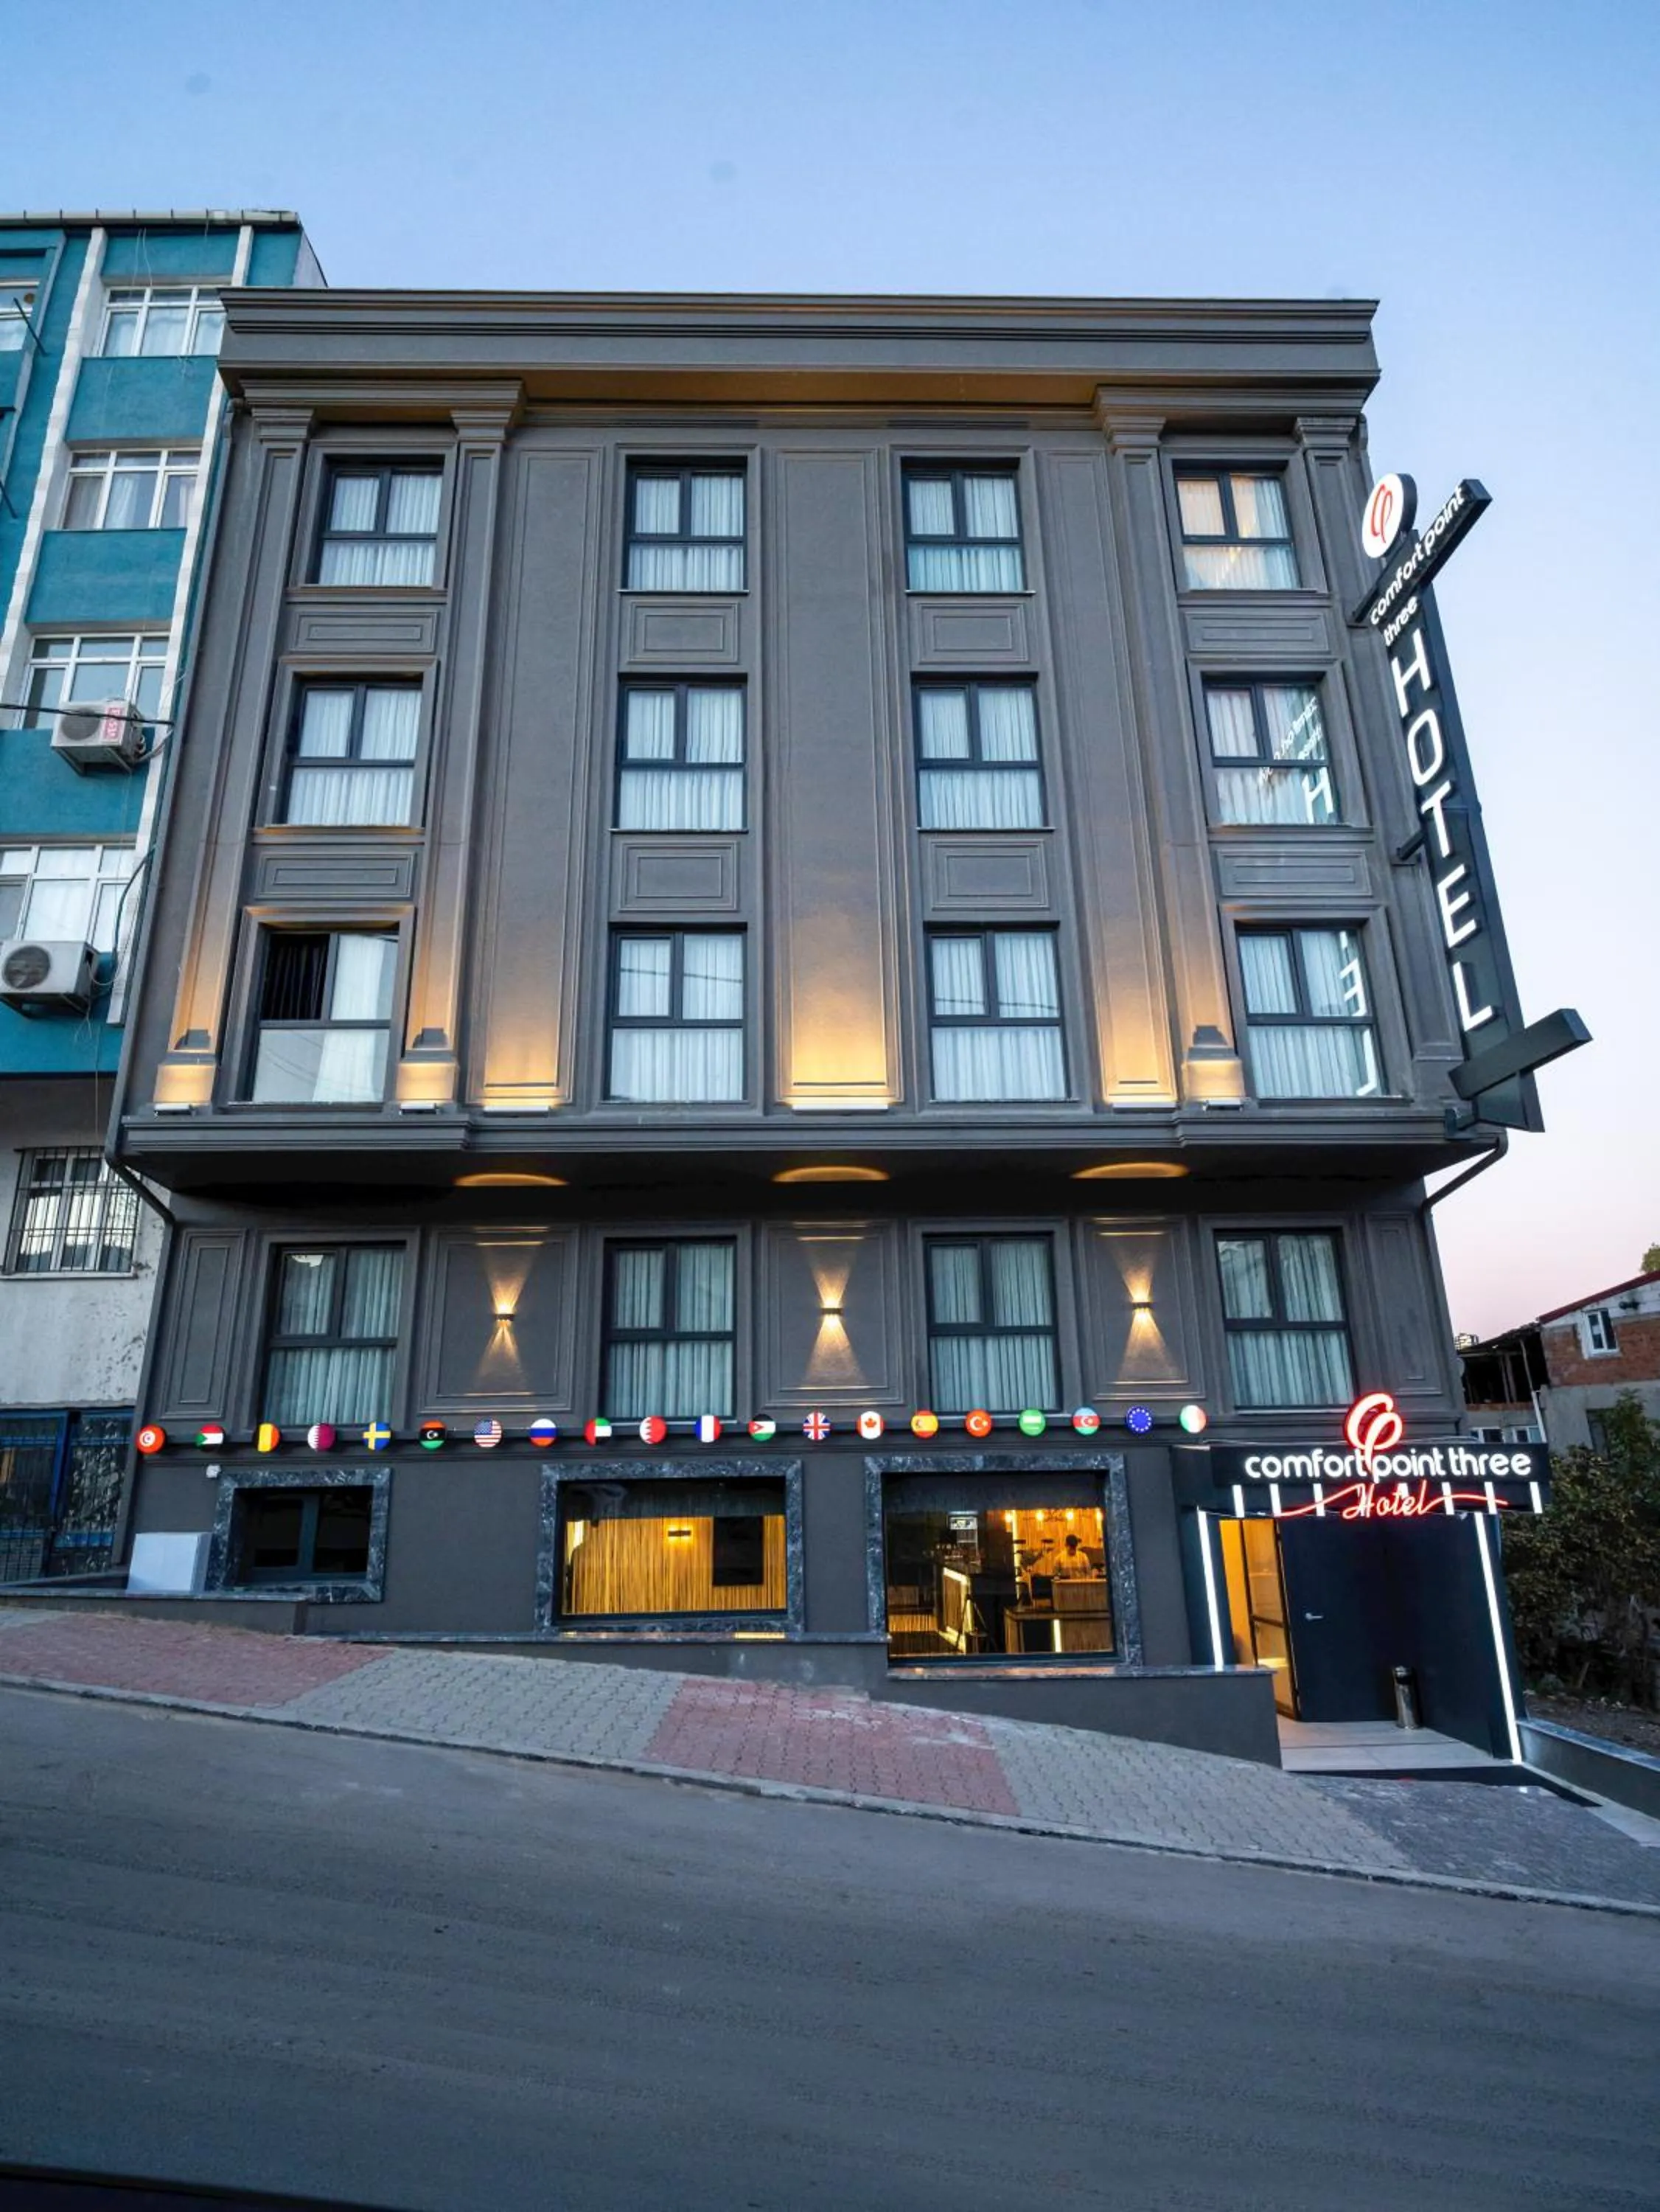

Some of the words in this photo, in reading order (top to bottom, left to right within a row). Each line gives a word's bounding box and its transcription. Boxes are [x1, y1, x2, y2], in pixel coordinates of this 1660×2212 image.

[1370, 541, 1424, 625] comfort
[1423, 484, 1465, 555] point
[1383, 595, 1417, 647] three
[1391, 628, 1493, 1032] HOTEL
[1245, 1448, 1367, 1478] comfort
[1372, 1447, 1445, 1484] point
[1448, 1447, 1532, 1475] three
